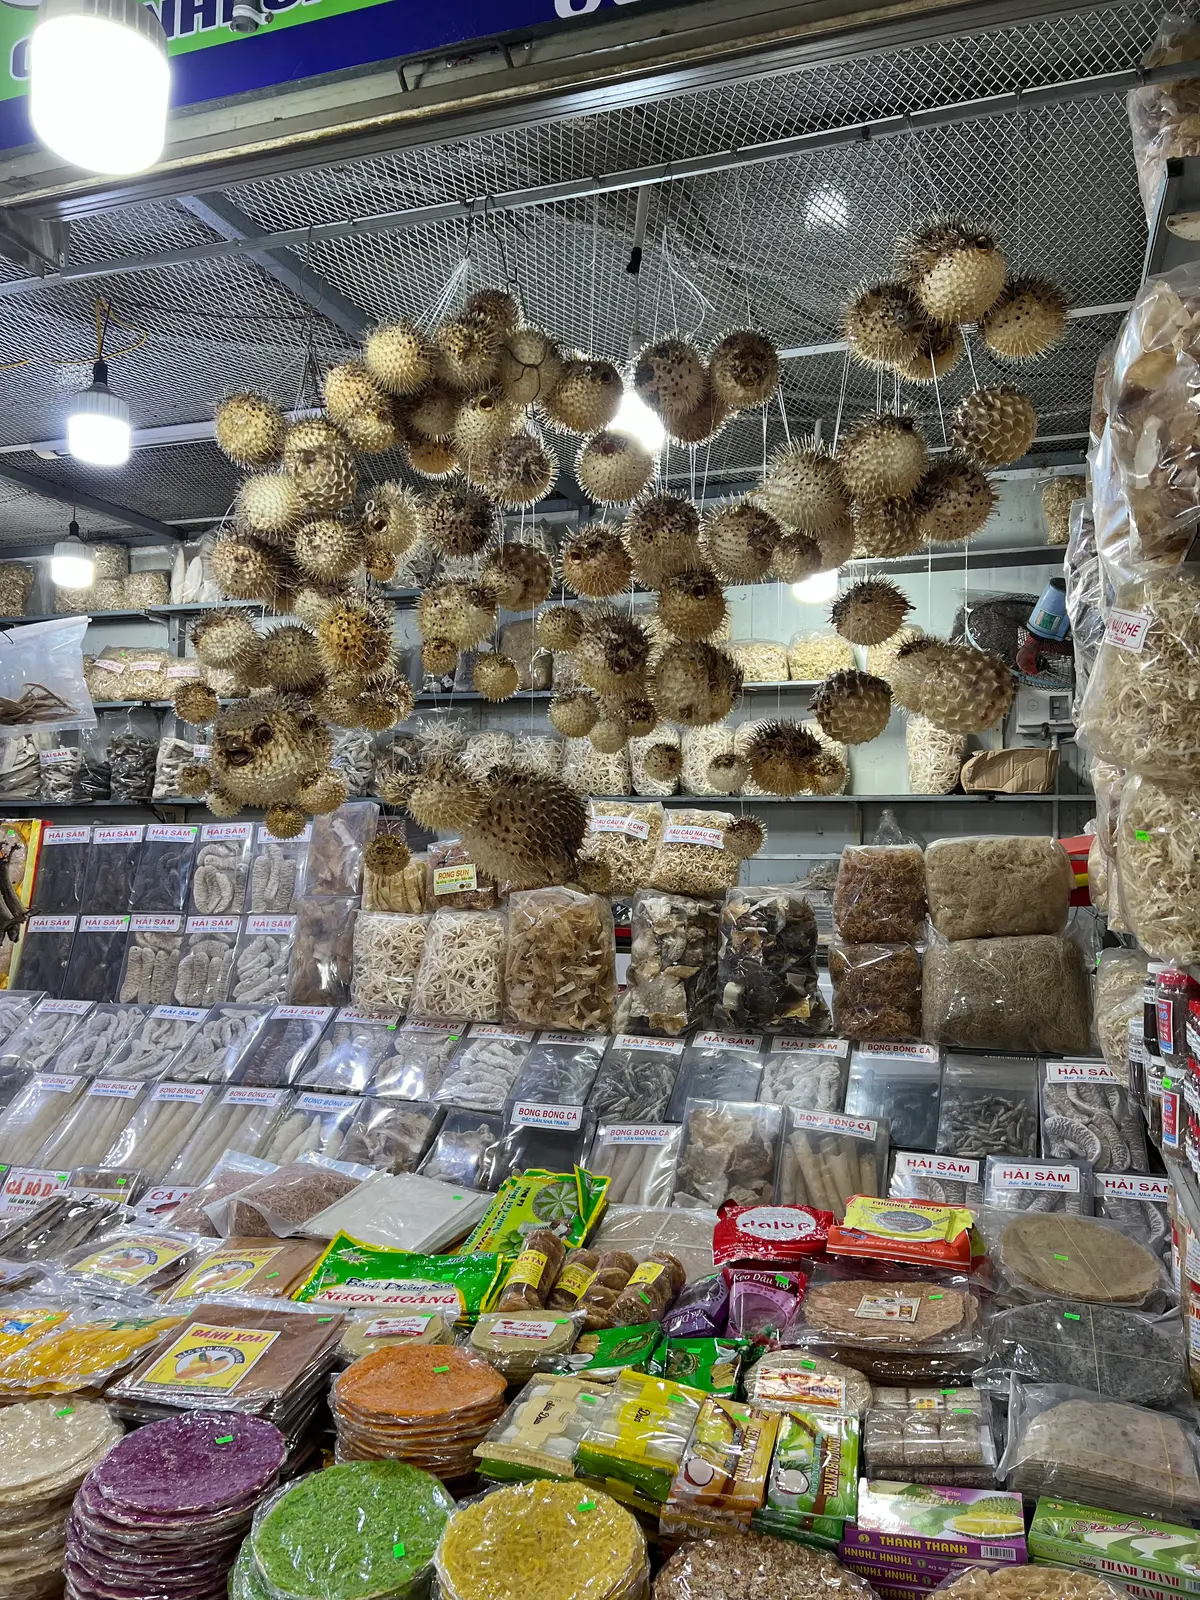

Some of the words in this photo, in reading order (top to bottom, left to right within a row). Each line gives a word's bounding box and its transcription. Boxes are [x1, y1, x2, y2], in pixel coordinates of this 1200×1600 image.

[1058, 1066, 1086, 1076] HẢI
[907, 1158, 936, 1170] HẢI
[937, 1160, 970, 1174] SÂM
[1003, 1170, 1030, 1180] HẢI
[1034, 1170, 1070, 1183] SÂM
[1105, 1179, 1134, 1192] HẢI
[151, 1189, 174, 1200] CÁ
[734, 1273, 751, 1282] Kẹo
[752, 1272, 772, 1285] Dâu
[191, 1329, 232, 1342] BÁNH
[233, 1332, 270, 1343] XOÀI
[879, 1536, 922, 1550] THANH
[925, 1541, 968, 1554] THANH
[1100, 1558, 1138, 1577] THANH
[1140, 1568, 1180, 1587] THANH
